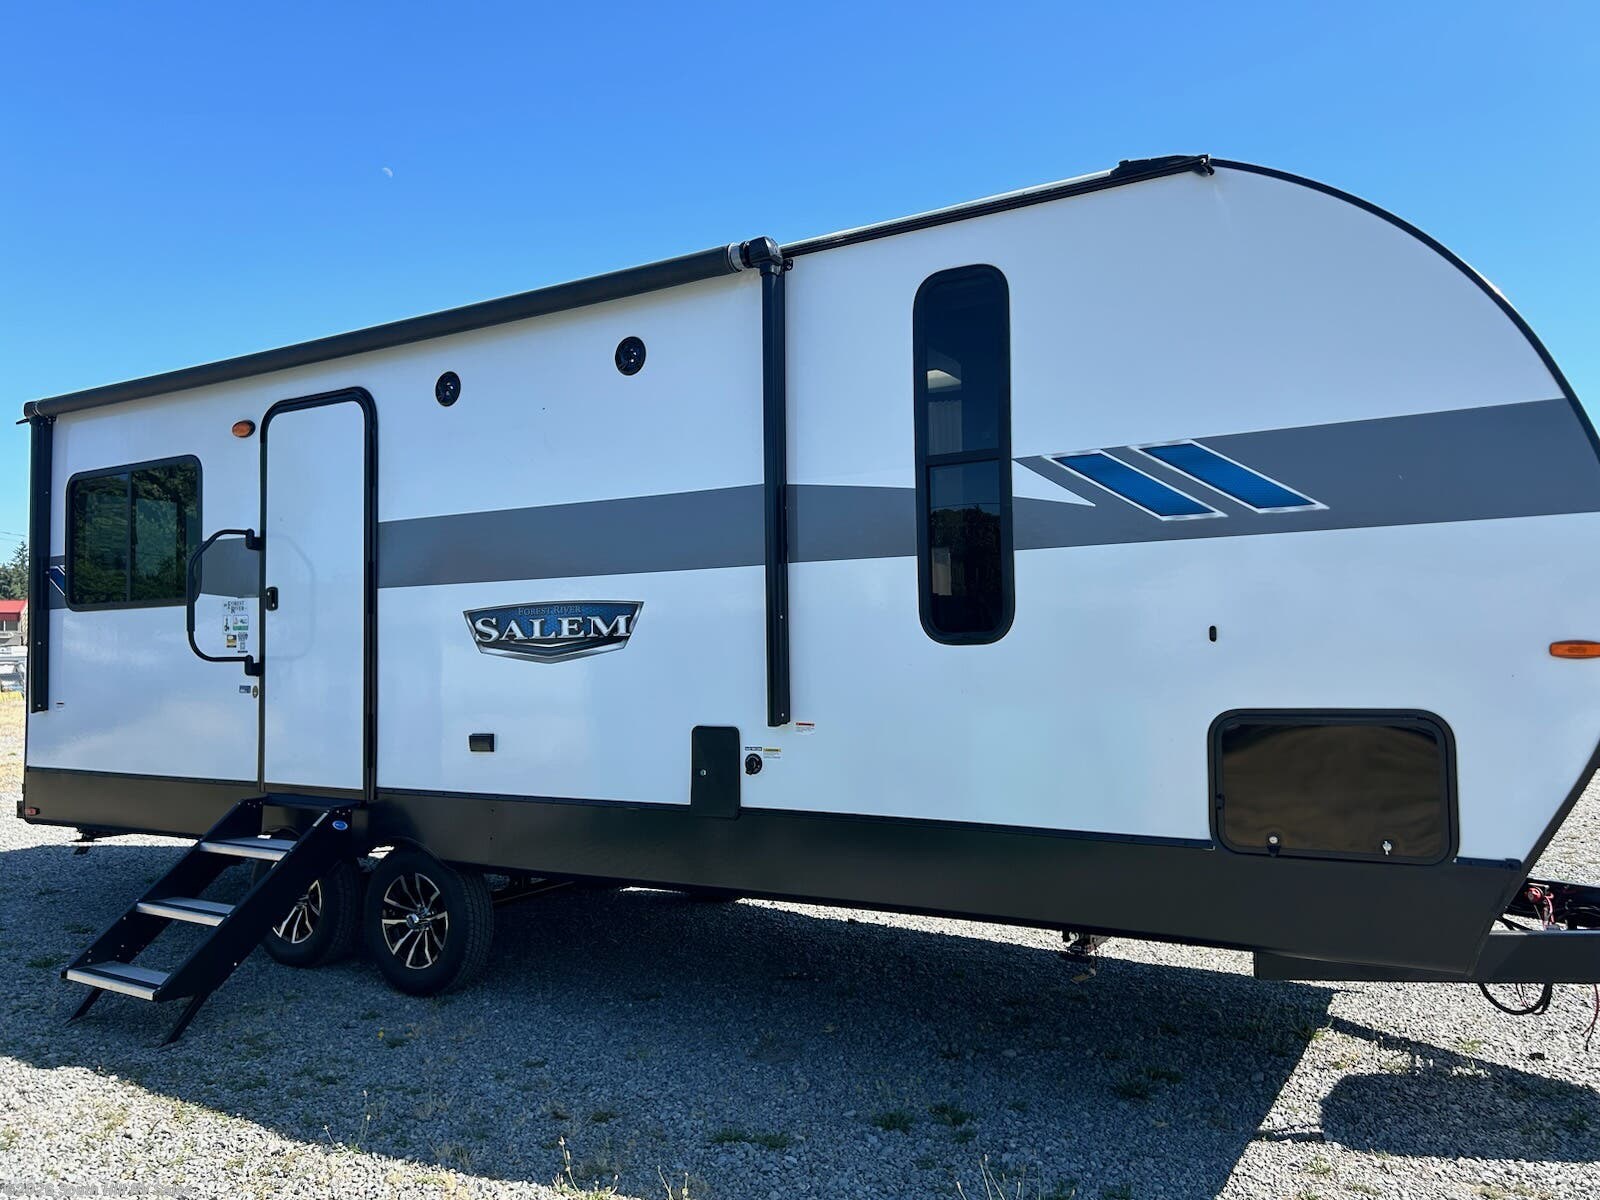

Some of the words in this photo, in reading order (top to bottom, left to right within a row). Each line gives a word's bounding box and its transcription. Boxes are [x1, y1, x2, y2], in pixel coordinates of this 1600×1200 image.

[518, 606, 550, 617] FOREST
[553, 605, 582, 615] RIVER
[475, 614, 631, 643] SALEM
